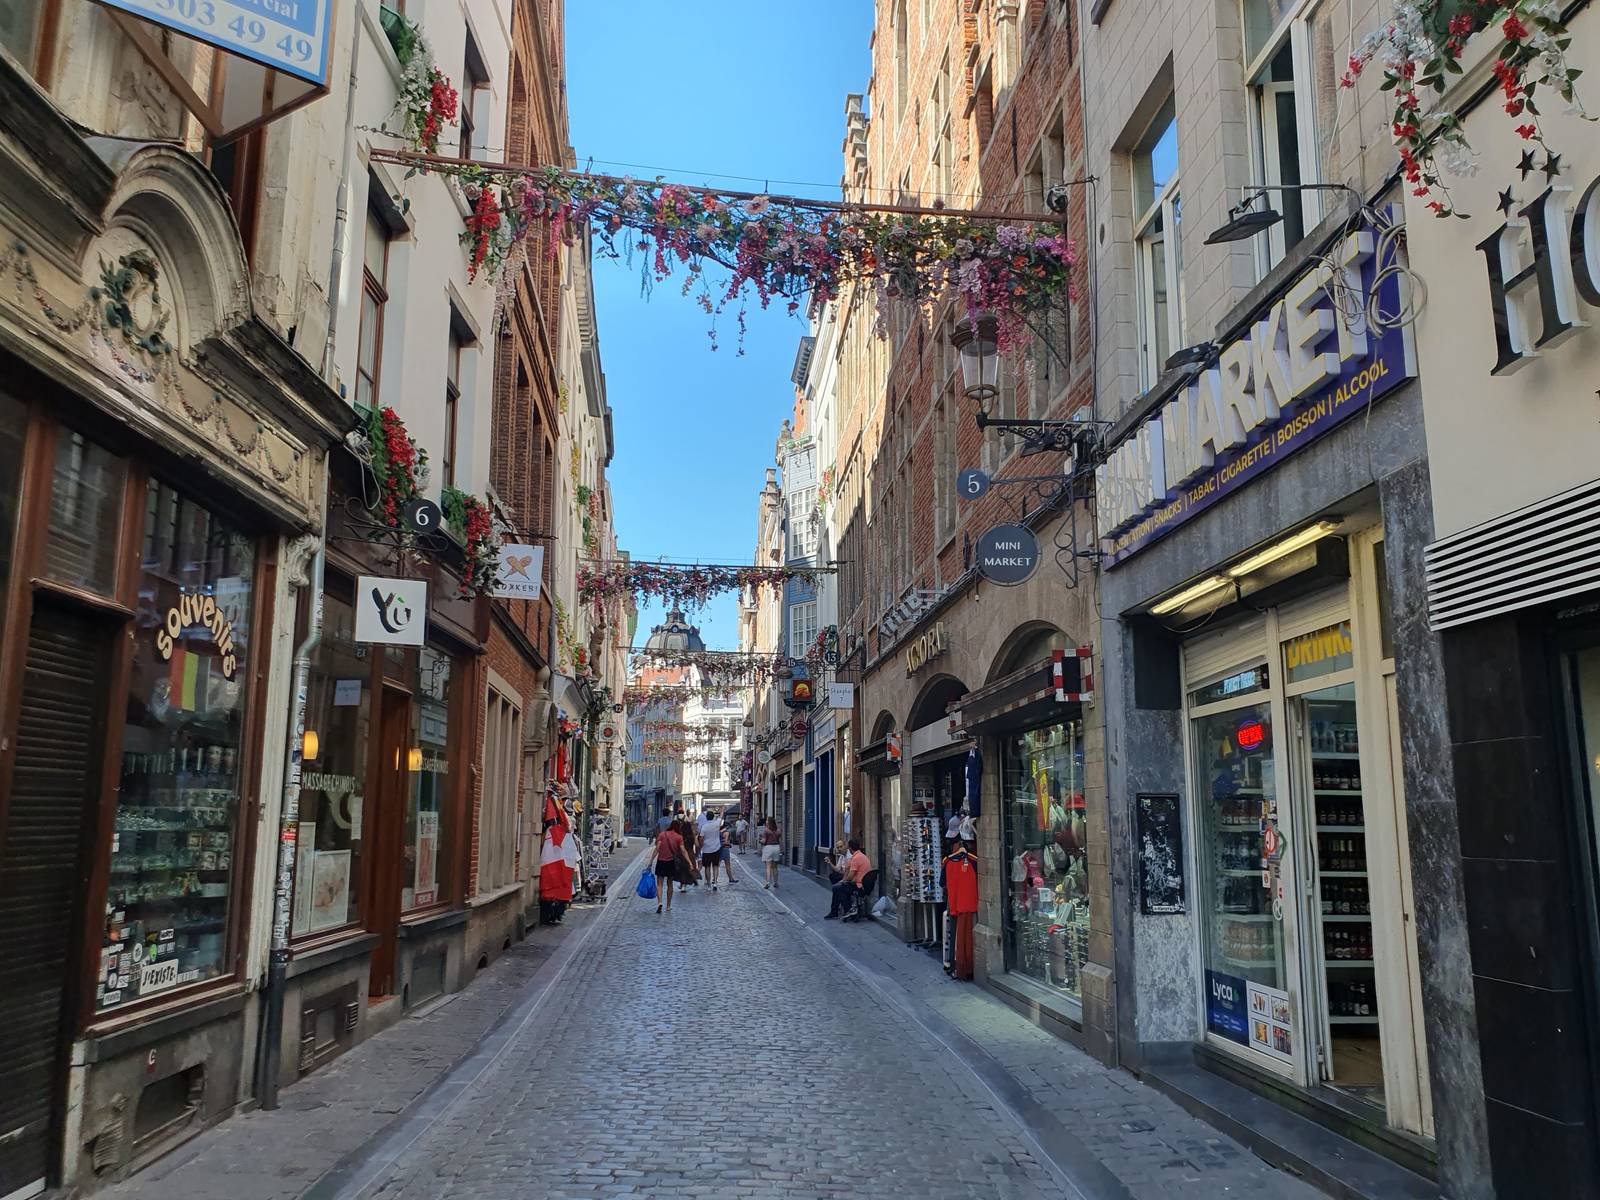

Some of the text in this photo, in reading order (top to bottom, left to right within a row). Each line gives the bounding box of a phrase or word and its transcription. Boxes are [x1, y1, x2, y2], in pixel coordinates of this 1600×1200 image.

[228, 14, 266, 43] 49
[276, 33, 313, 62] 49
[1163, 231, 1375, 490] MARKET
[1154, 499, 1182, 528] SNACKS
[1188, 477, 1216, 504] TABAC
[1220, 438, 1271, 483] CIGARETTE
[1277, 399, 1326, 446] BOISSON
[1335, 358, 1390, 408] ALCOOL
[967, 474, 980, 493] 5
[415, 506, 430, 526] 6
[995, 541, 1021, 550] MINI
[984, 556, 1032, 567] MARKET
[827, 652, 836, 662] 13
[1212, 978, 1233, 1002] Lyca
